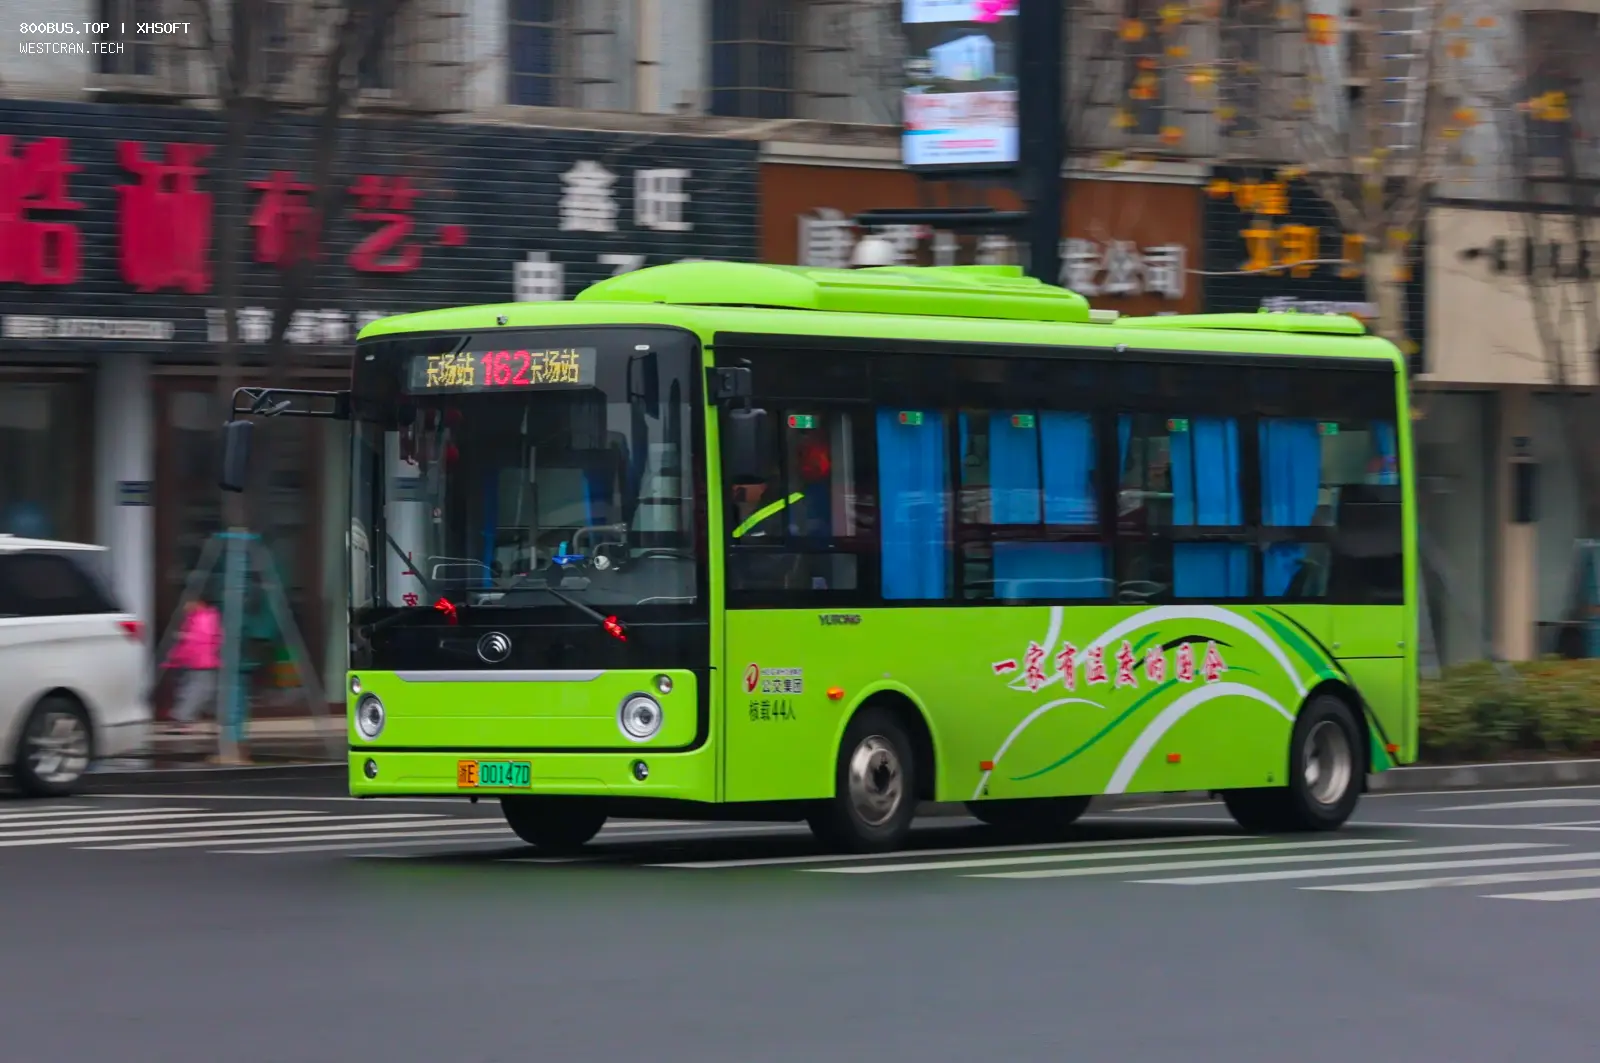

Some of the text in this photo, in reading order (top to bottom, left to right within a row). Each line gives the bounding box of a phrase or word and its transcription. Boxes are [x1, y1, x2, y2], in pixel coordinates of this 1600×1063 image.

[557, 159, 694, 232] 鑫旺
[480, 349, 530, 386] 162
[762, 678, 803, 693] 公交集团
[749, 699, 797, 722] 核载44人
